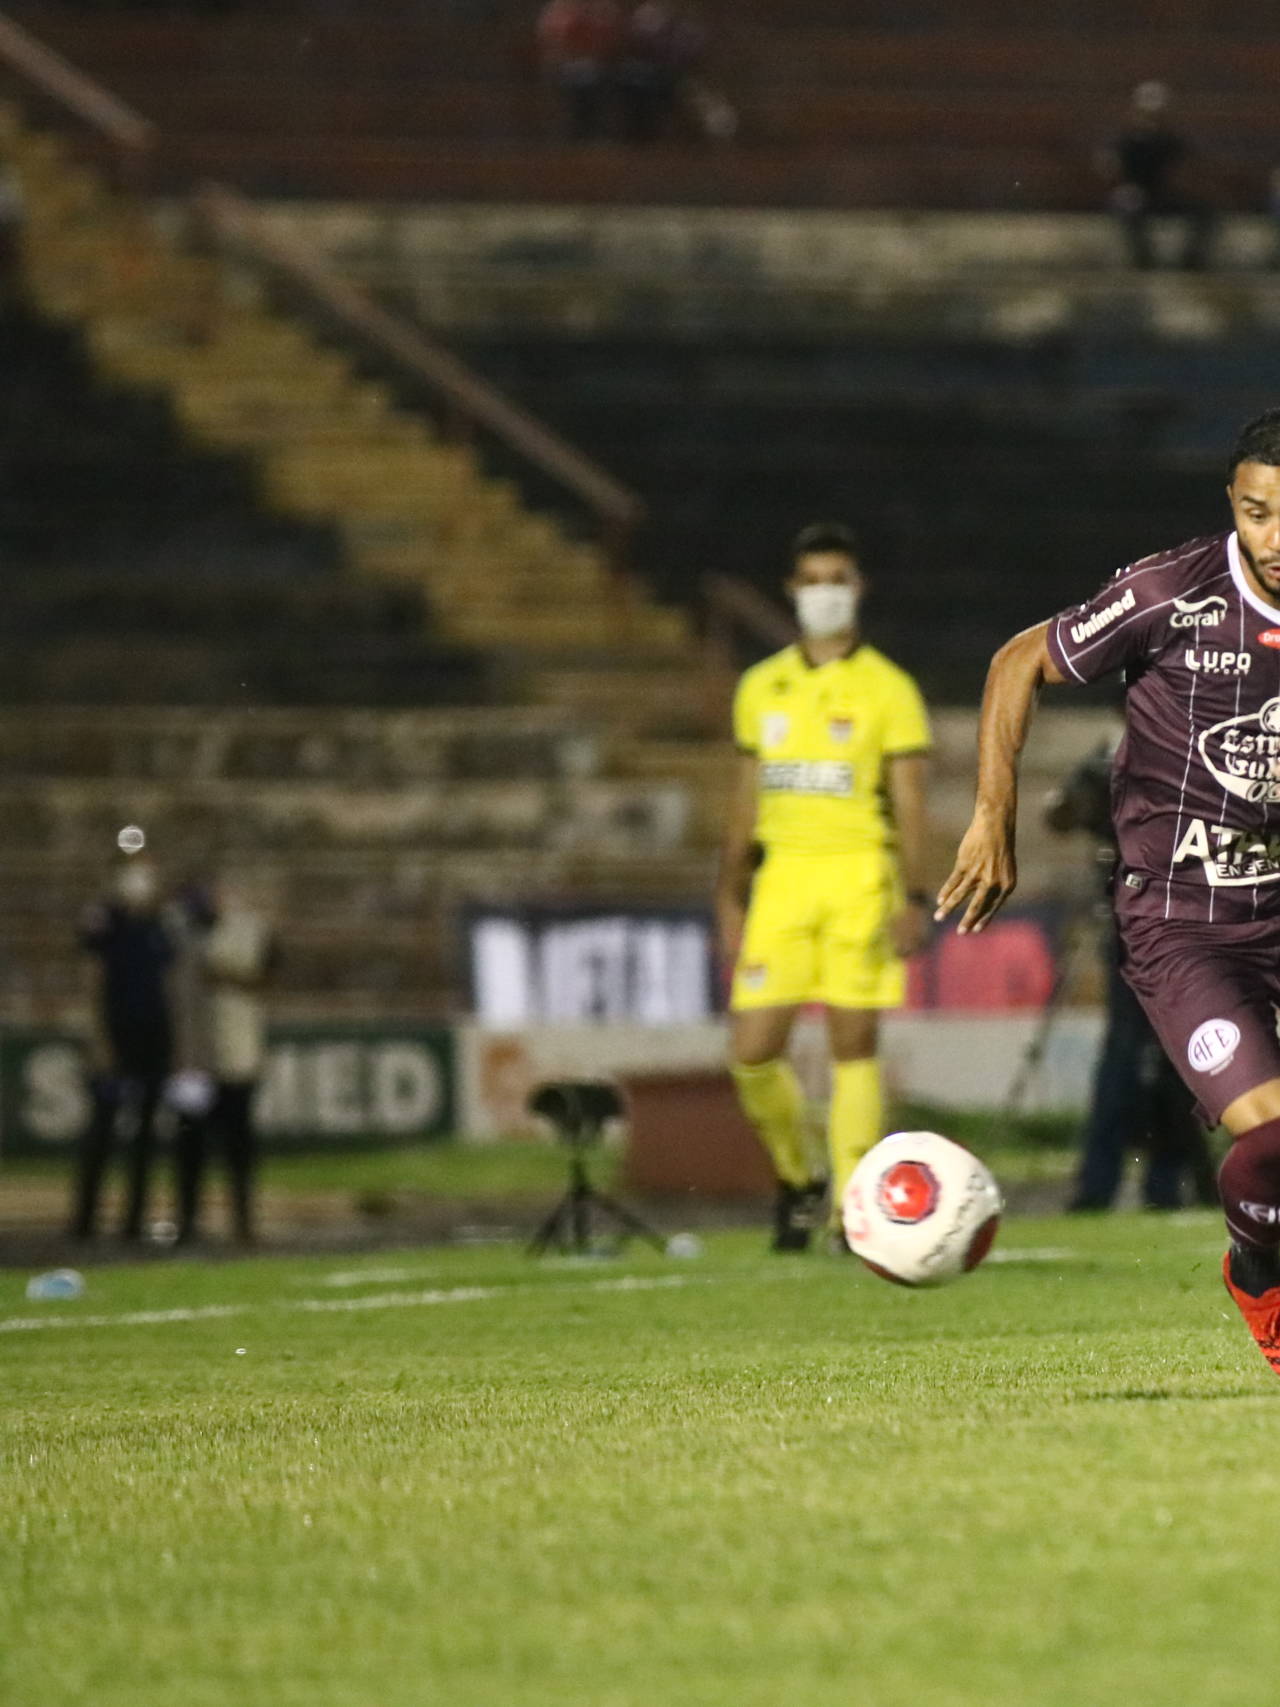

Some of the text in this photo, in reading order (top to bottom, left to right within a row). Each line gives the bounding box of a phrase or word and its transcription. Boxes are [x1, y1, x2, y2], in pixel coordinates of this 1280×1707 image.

[1070, 588, 1136, 644] Unimed
[1169, 609, 1221, 628] Coral
[1185, 648, 1251, 671] LUPO
[1194, 1028, 1230, 1062] AFE
